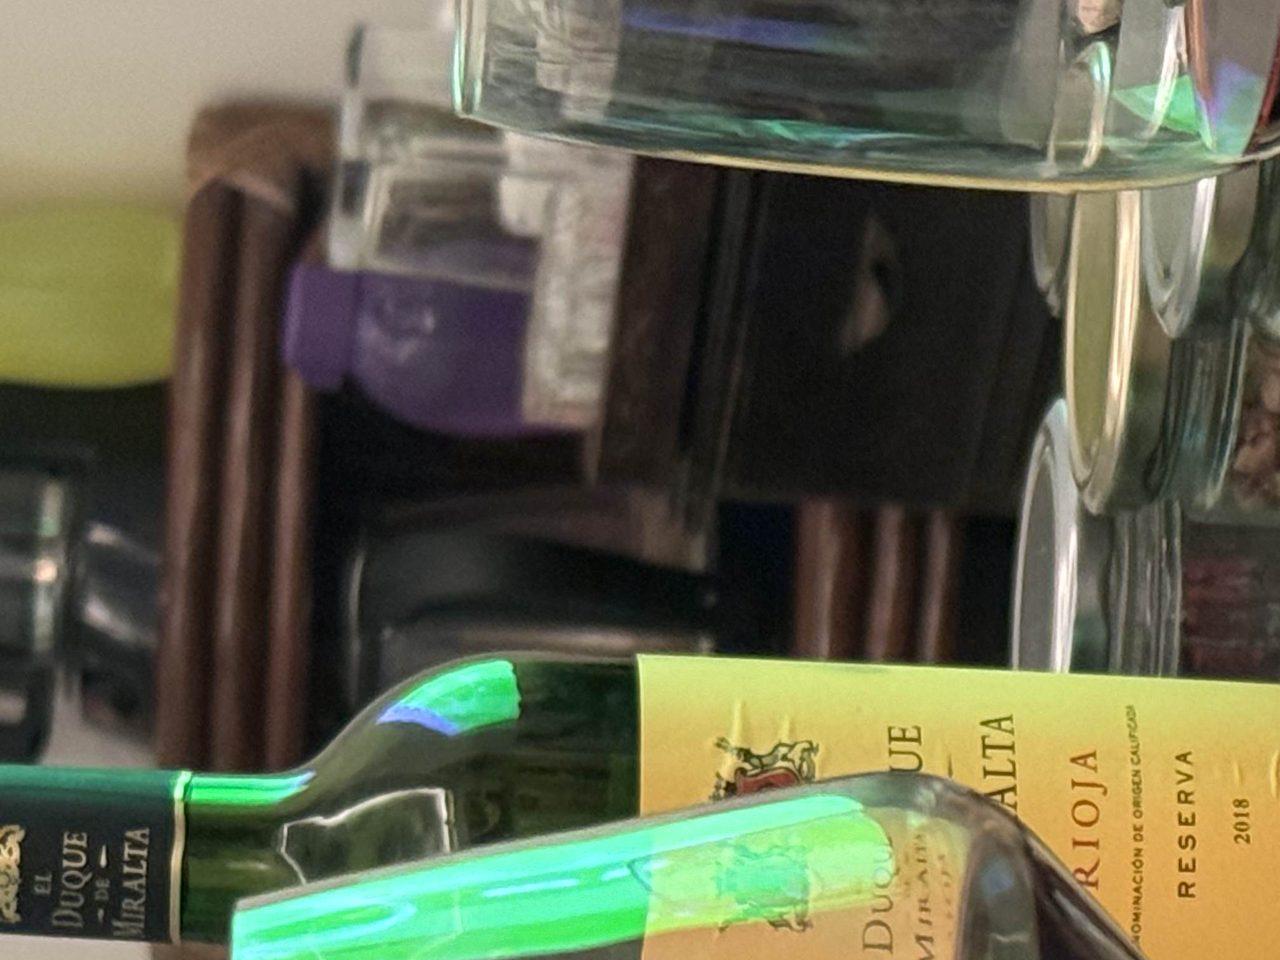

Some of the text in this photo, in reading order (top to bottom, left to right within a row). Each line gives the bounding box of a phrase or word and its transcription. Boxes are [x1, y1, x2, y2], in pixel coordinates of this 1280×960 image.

[978, 713, 1018, 811] ALTA
[1131, 769, 1144, 820] ORIGEN
[1069, 749, 1108, 891] RIOJA
[1133, 824, 1144, 843] DE
[1174, 750, 1197, 899] RESERVA
[1232, 798, 1250, 845] 2018
[33, 871, 53, 896] EL
[51, 830, 93, 929] DUQUE
[94, 877, 111, 901] DE
[112, 826, 150, 939] MIRALTA
[1130, 848, 1144, 945] NOMINACIÓN
